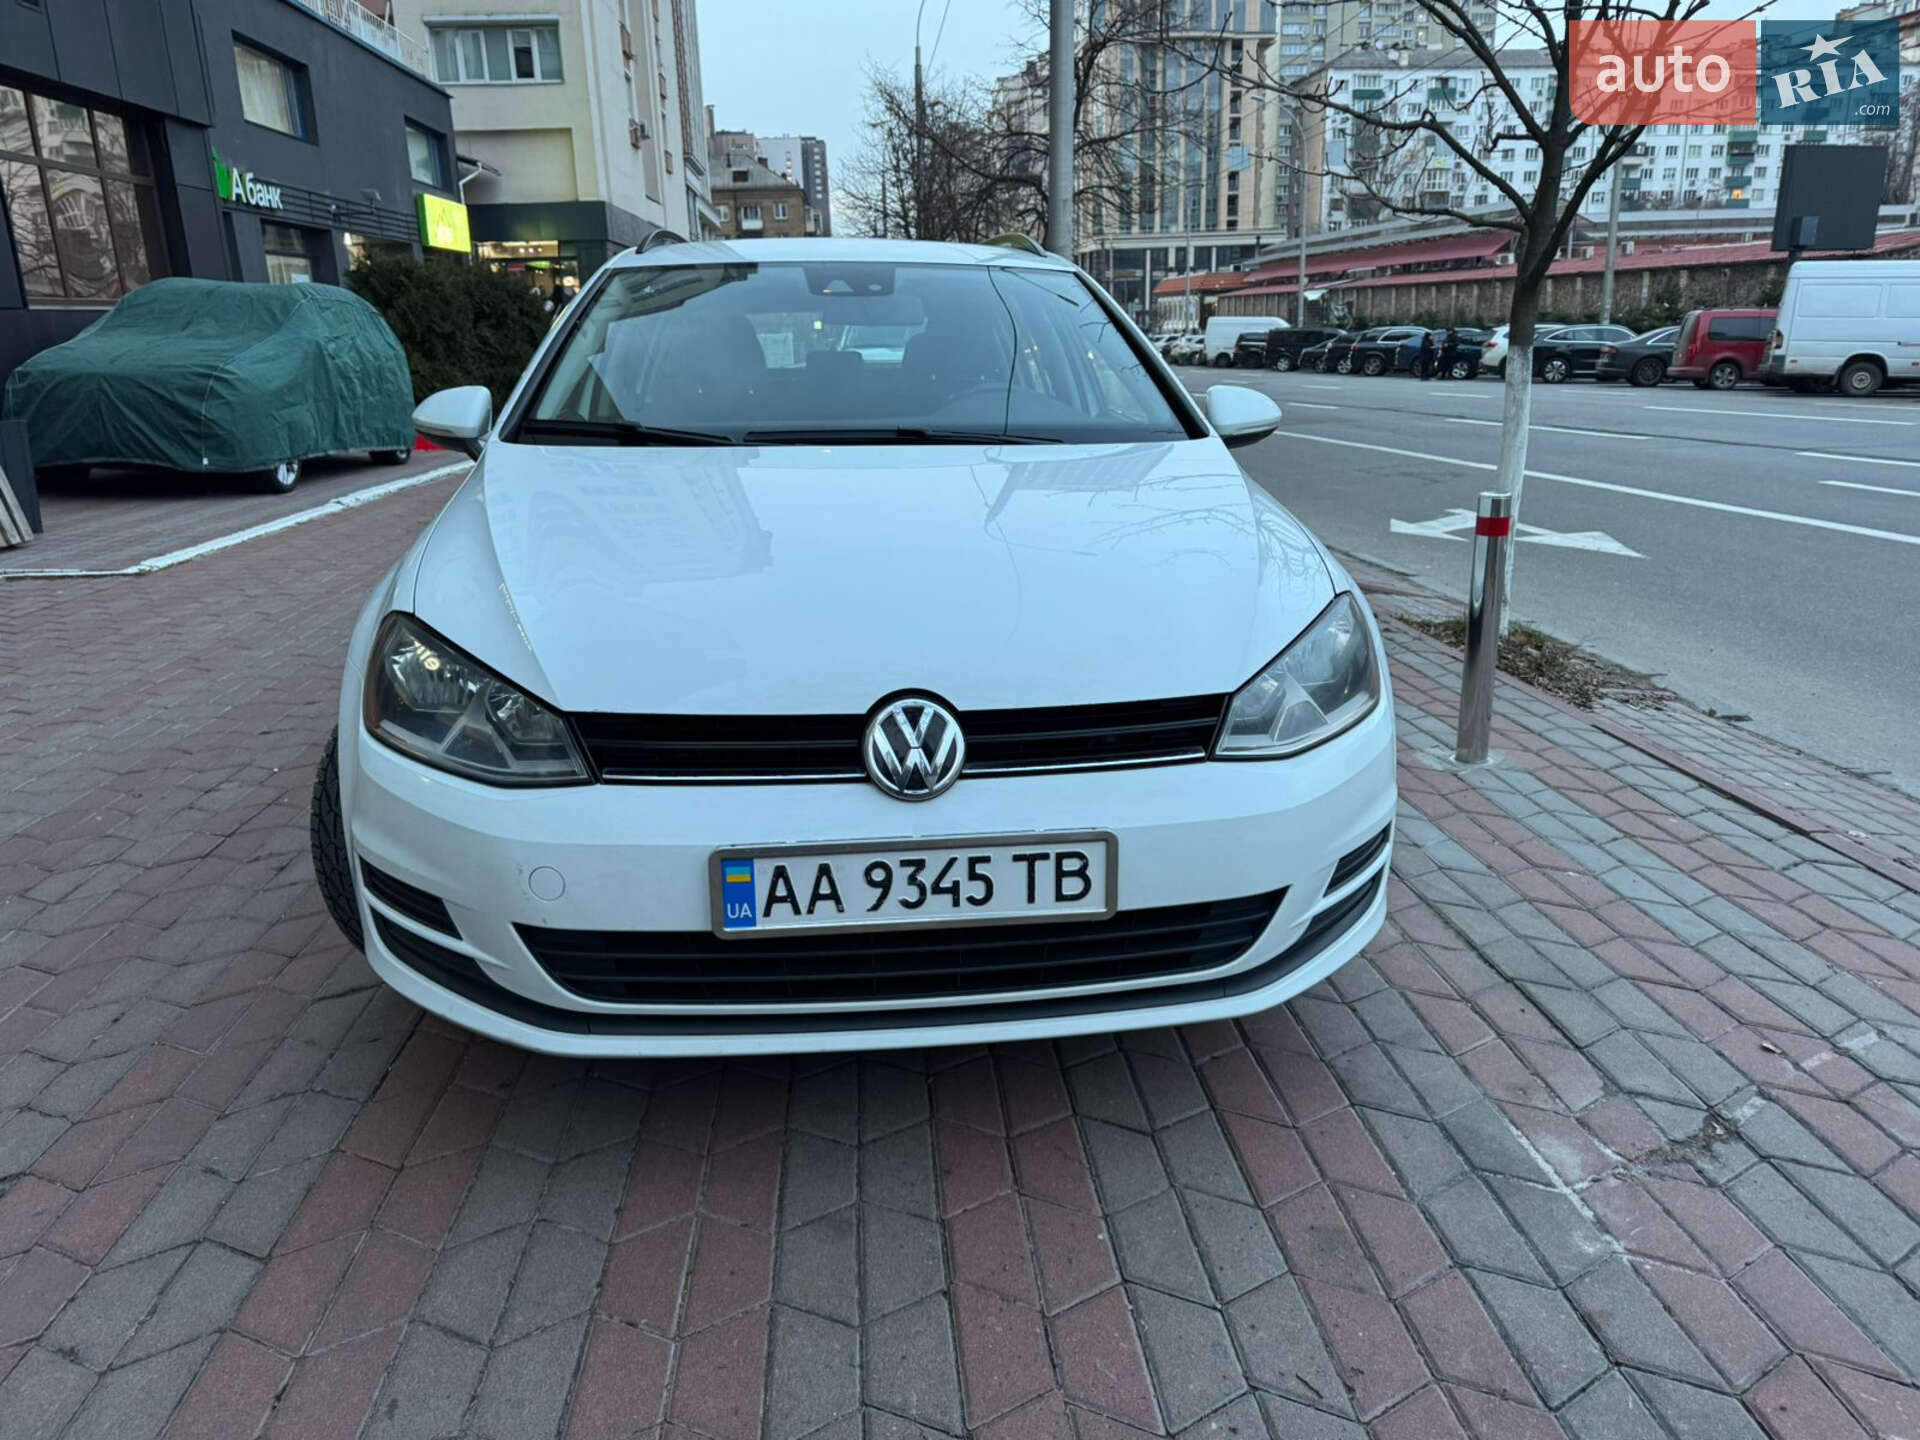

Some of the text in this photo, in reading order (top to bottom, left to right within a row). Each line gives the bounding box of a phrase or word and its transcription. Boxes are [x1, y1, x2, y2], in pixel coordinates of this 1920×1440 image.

[762, 851, 1092, 917] AA 9345 TB
[726, 903, 753, 919] UA
